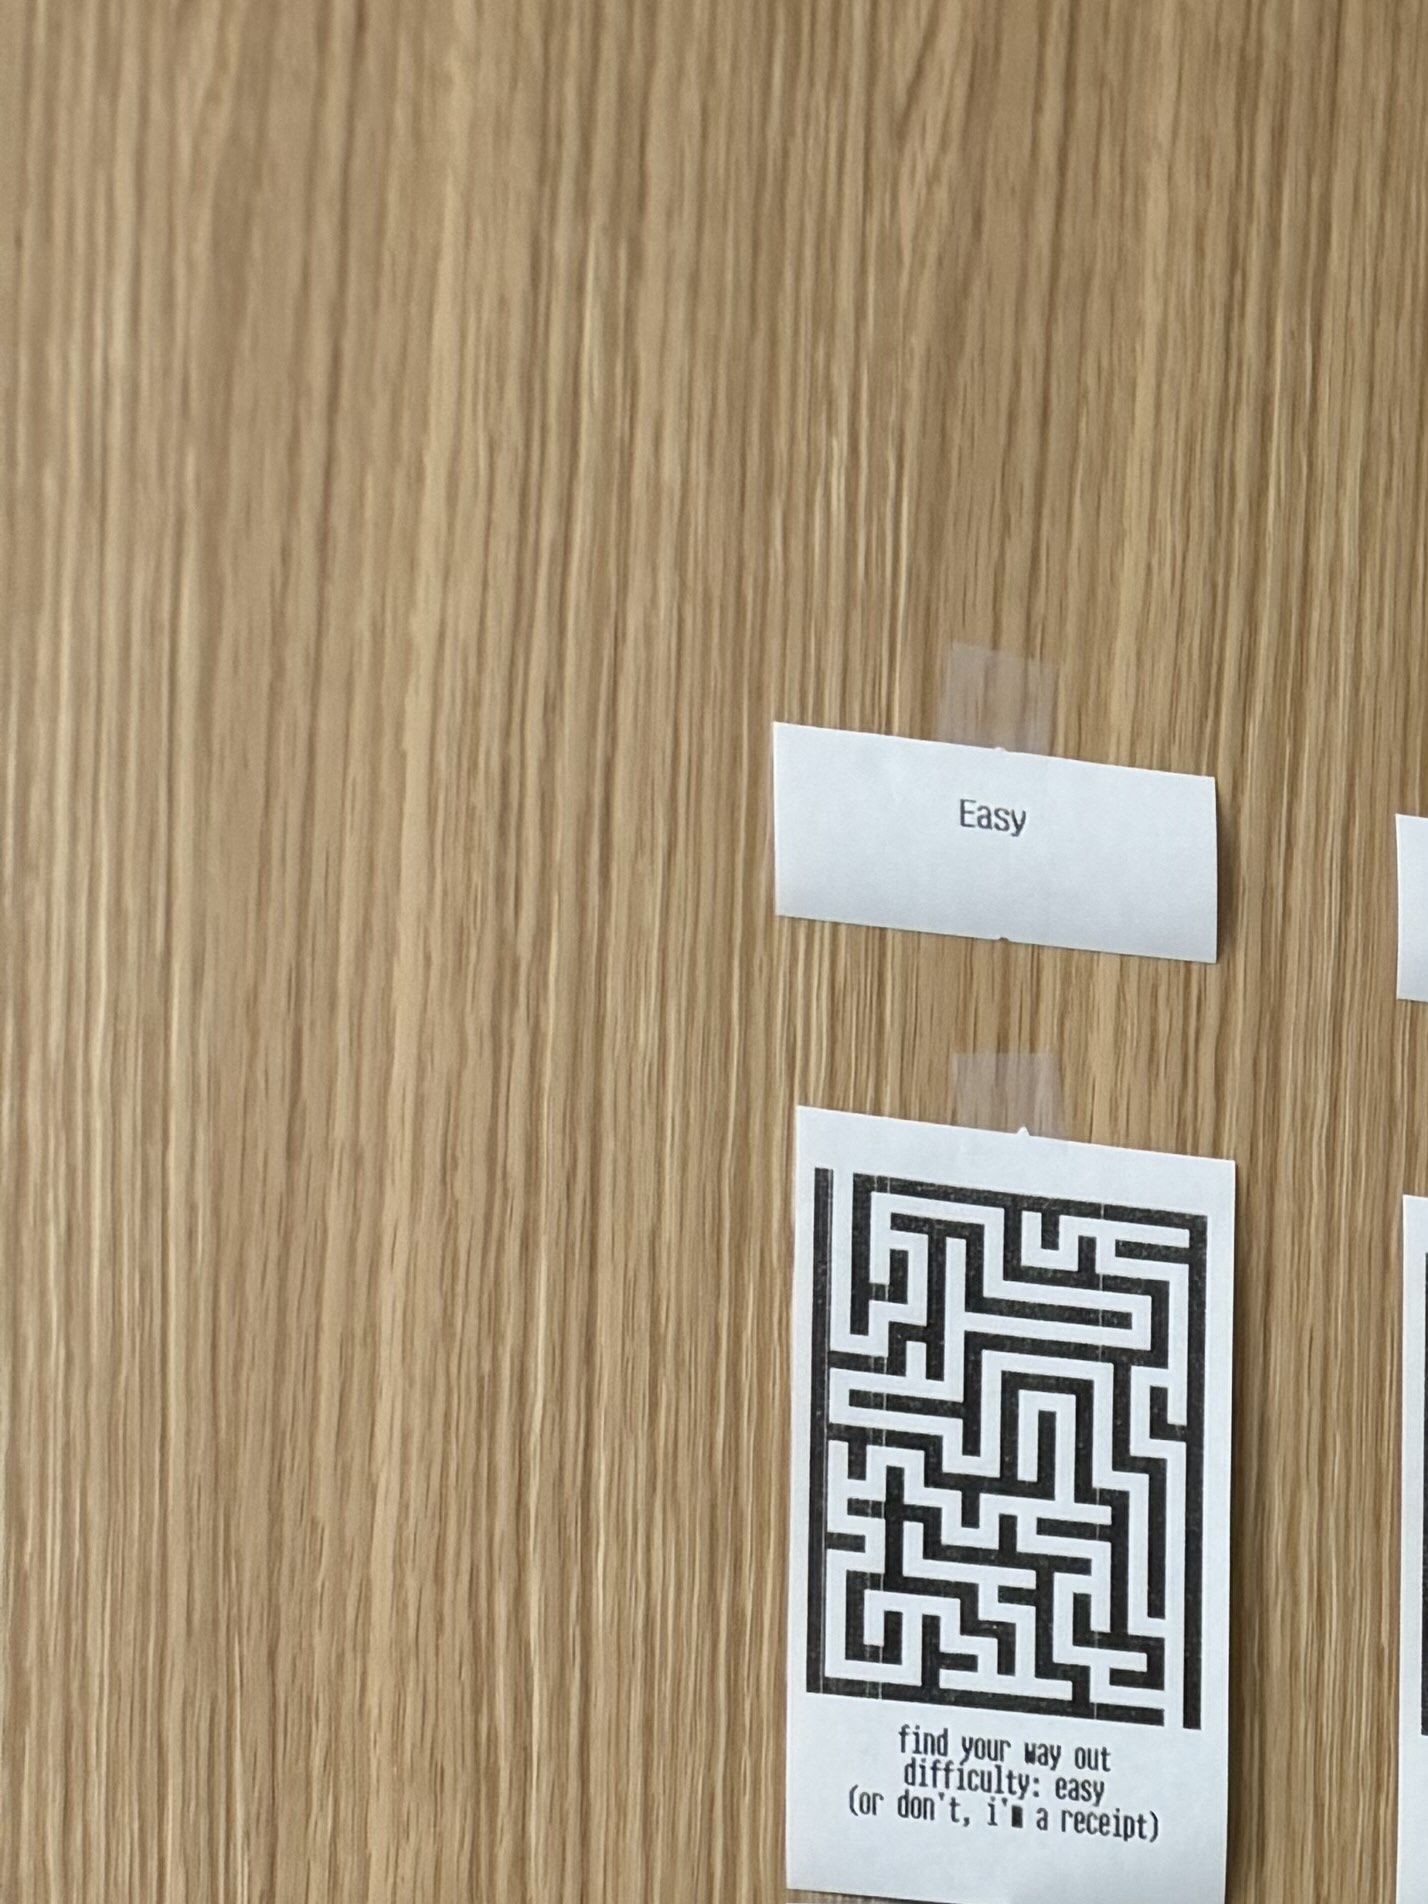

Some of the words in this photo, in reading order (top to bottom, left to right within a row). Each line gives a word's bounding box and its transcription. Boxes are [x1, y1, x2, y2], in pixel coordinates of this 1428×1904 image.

[960, 798, 1027, 838] Easy
[899, 1724, 948, 1757] find
[962, 1736, 1011, 1763] your
[1025, 1743, 1061, 1771] way
[1075, 1747, 1110, 1772] out
[904, 1757, 1039, 1800] difficulty:
[1055, 1777, 1104, 1807] easy
[849, 1785, 884, 1816] (or
[898, 1789, 969, 1827] don't,
[1036, 1808, 1048, 1830] a
[1061, 1808, 1158, 1842] receipt)
